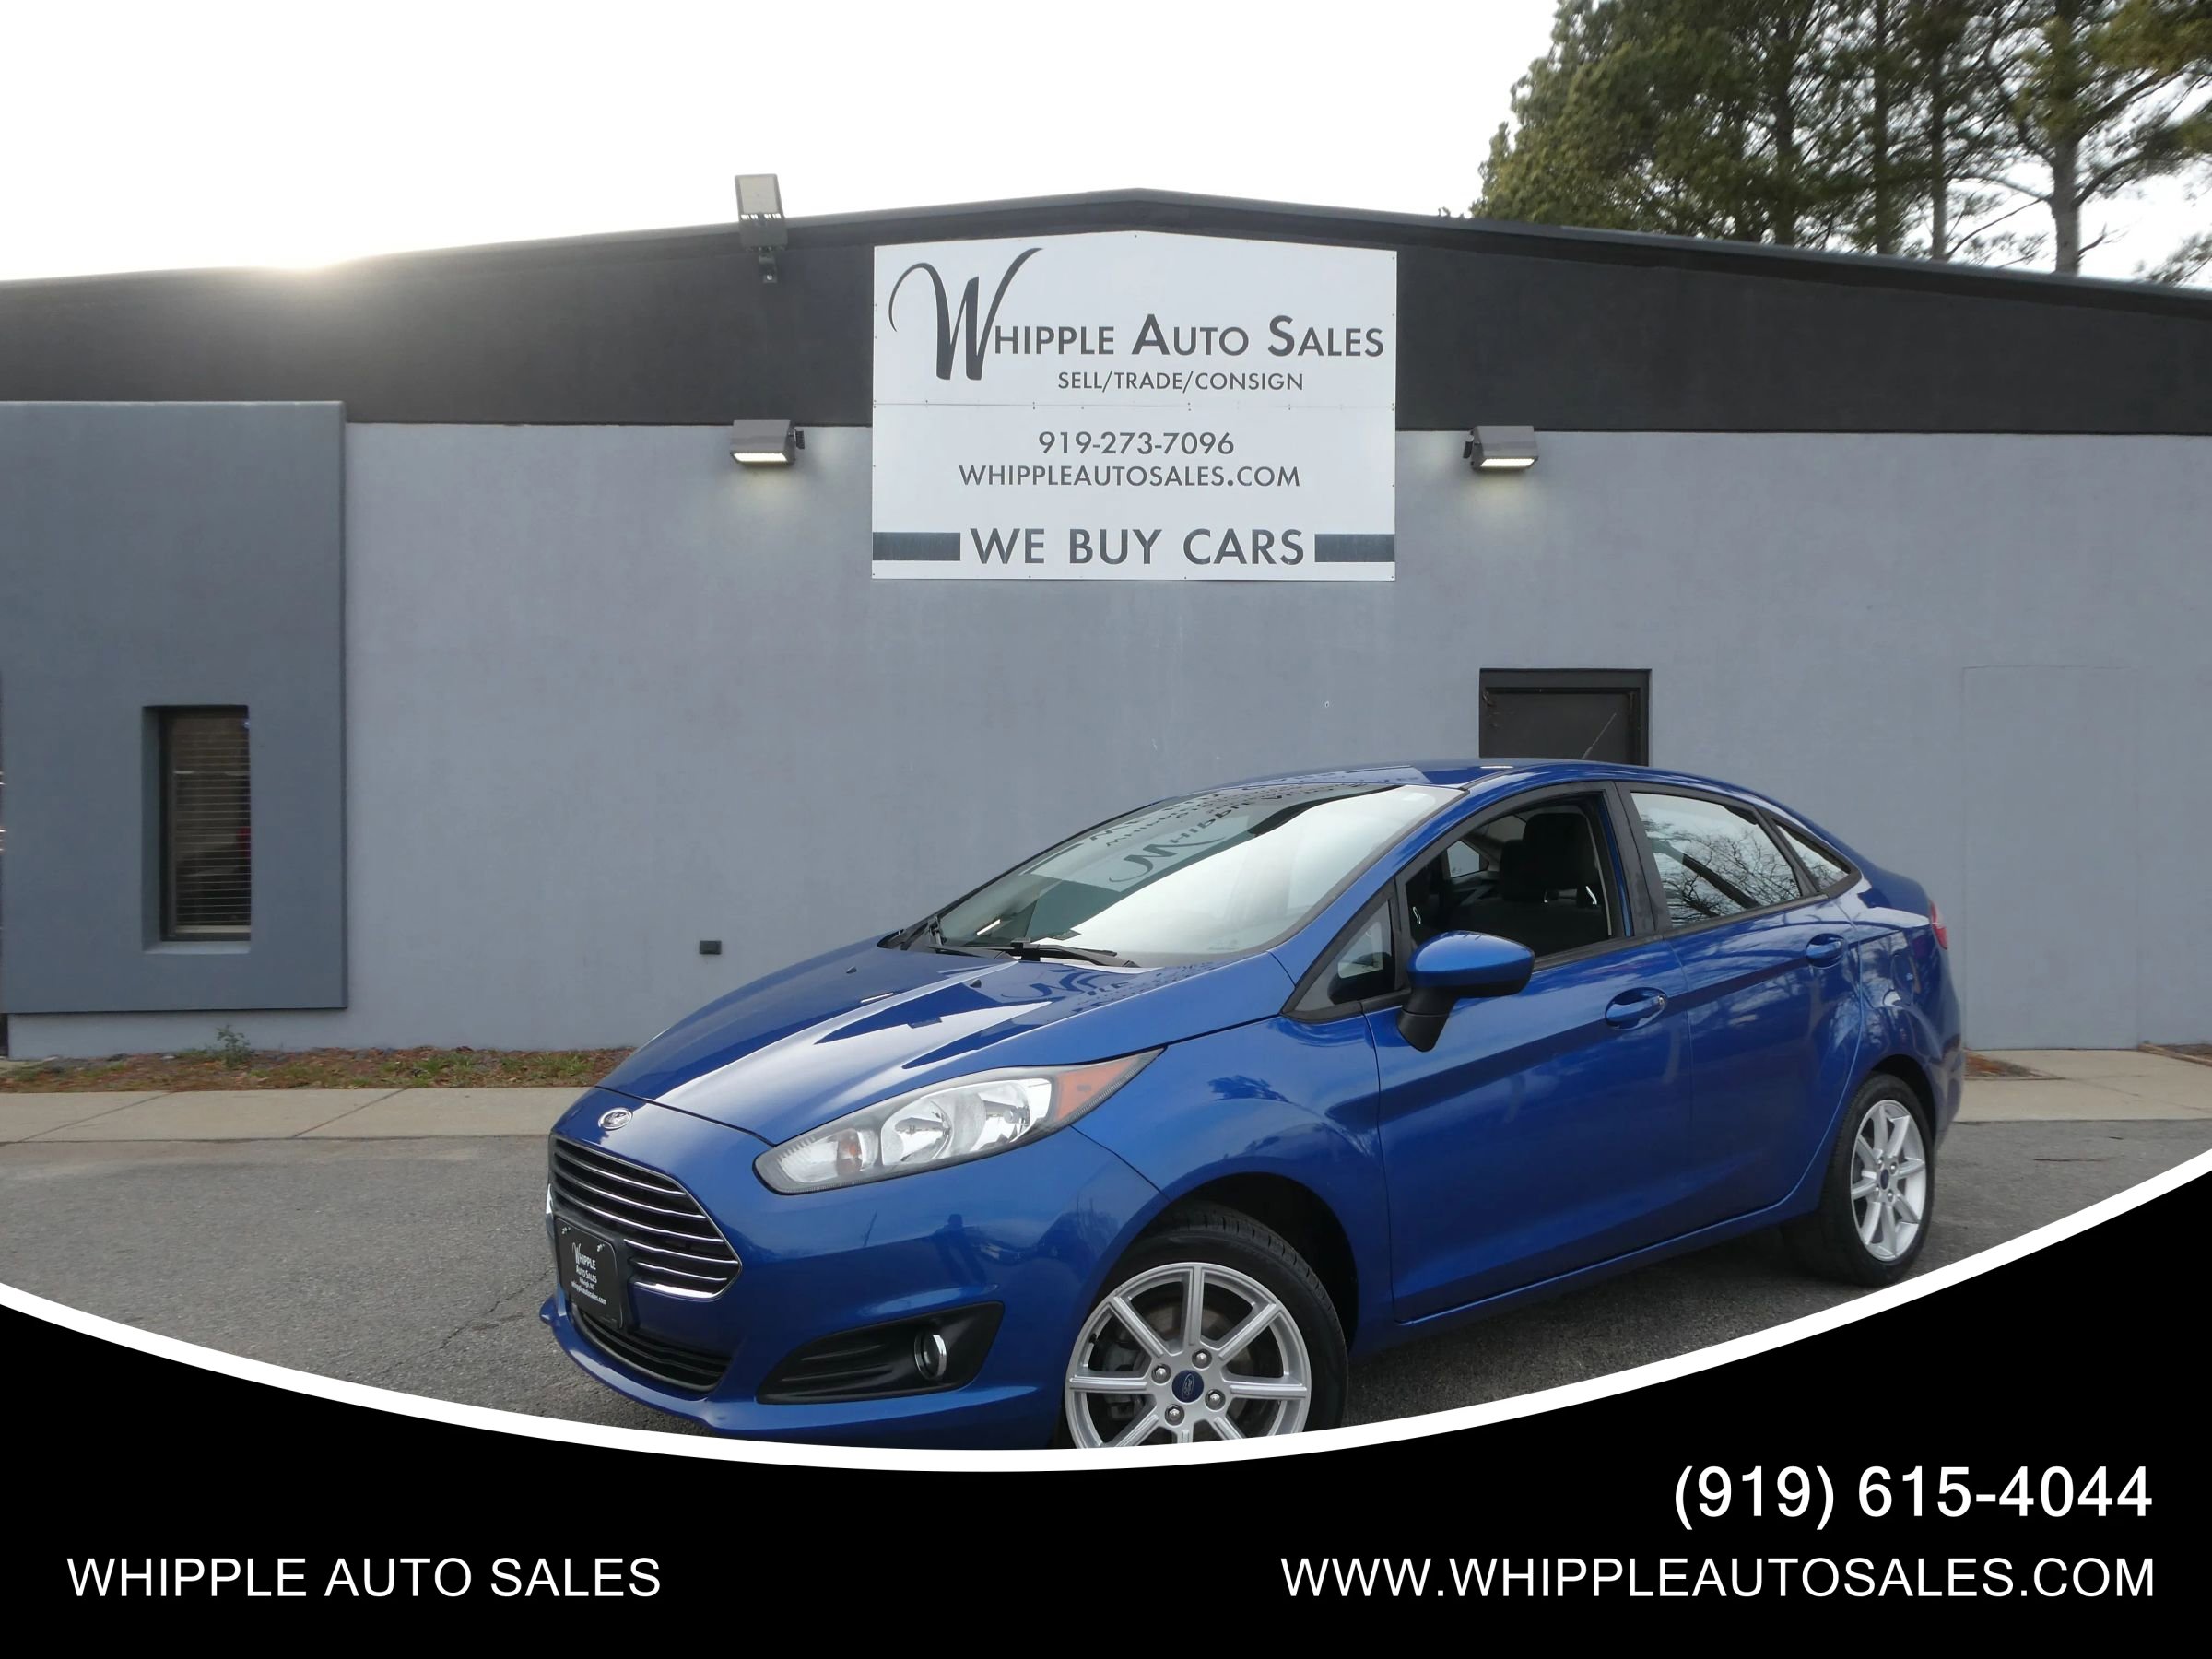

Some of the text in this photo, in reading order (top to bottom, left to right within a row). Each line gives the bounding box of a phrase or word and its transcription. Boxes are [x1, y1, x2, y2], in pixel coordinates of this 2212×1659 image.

[888, 247, 1384, 381] WHIPPLE AUTO SALES
[1058, 370, 1304, 392] SELL/TRADE/CONSIGN
[1038, 430, 1234, 455] 919-273-7096
[958, 465, 1301, 487] WHIPPLEAUTOSALES.COM
[970, 527, 1305, 566] WE BUY CARS
